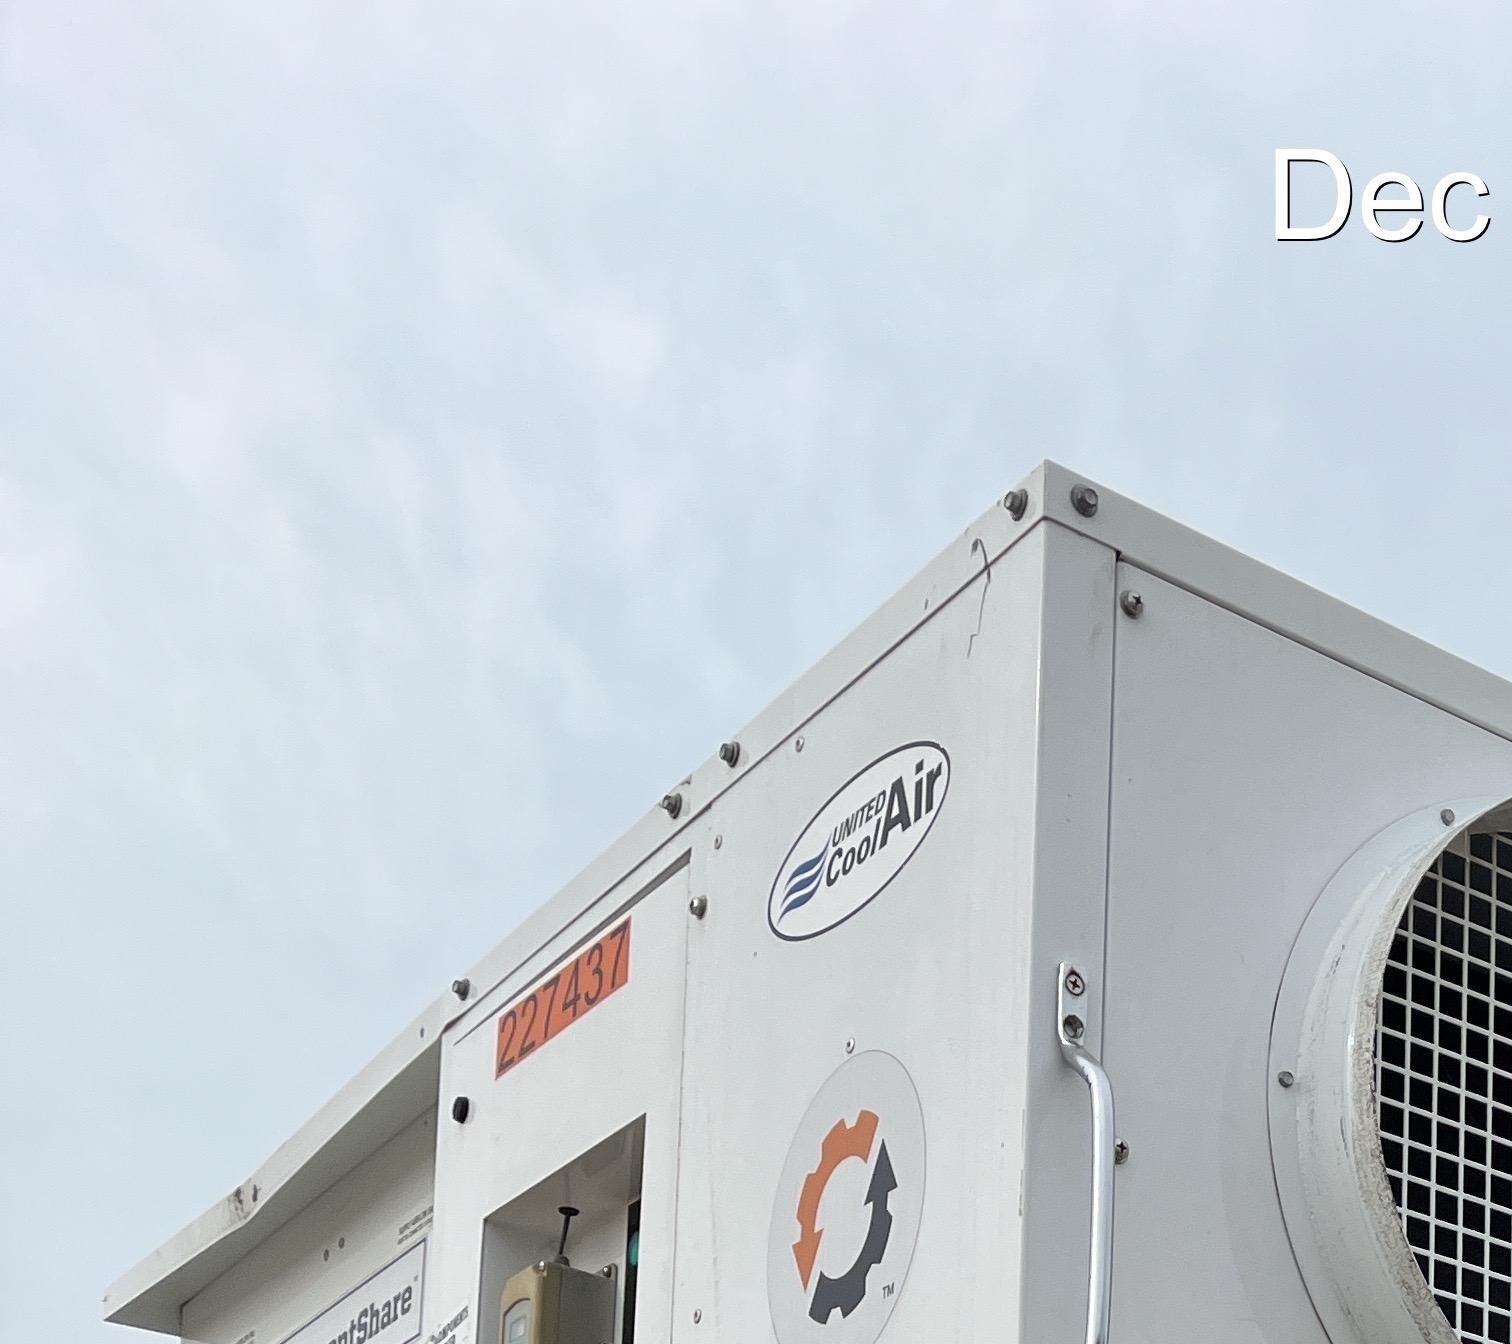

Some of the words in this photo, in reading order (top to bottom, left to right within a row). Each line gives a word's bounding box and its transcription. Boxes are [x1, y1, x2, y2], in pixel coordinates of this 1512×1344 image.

[831, 789, 887, 848] UNITED
[497, 919, 631, 1074] 227437
[882, 1281, 895, 1300] TM
